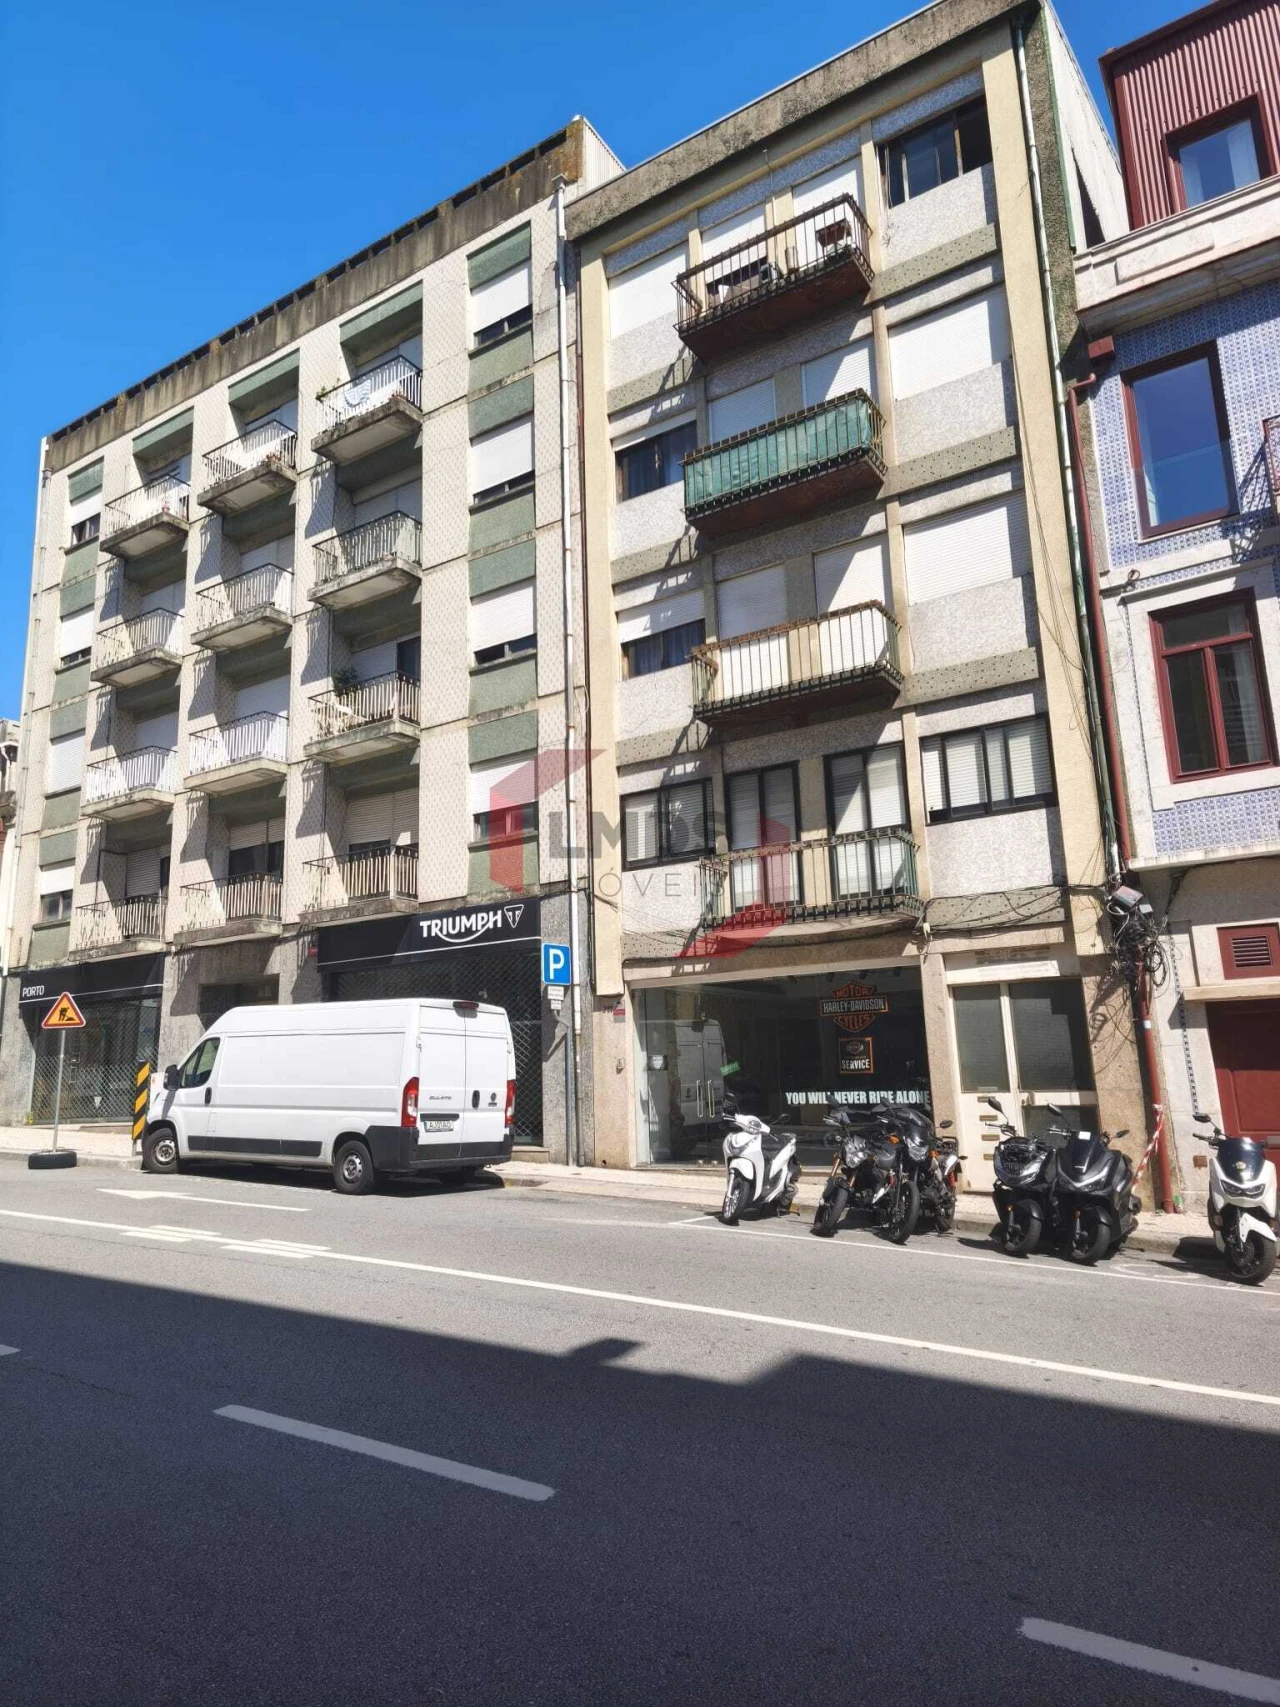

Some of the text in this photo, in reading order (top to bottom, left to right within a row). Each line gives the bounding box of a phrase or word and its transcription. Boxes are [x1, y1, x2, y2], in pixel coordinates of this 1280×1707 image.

[419, 909, 502, 942] TRIUMPH
[549, 949, 565, 980] P
[22, 985, 45, 998] PORTO
[833, 984, 870, 998] MOTOR
[823, 998, 885, 1013] HARLEY-DAVIDSON
[838, 1014, 871, 1030] CYCLES
[842, 1058, 870, 1070] SERVICE
[785, 1092, 806, 1105] YOU
[807, 1092, 830, 1105] WIL
[834, 1091, 867, 1104] NEVER
[896, 1091, 930, 1104] ALONE
